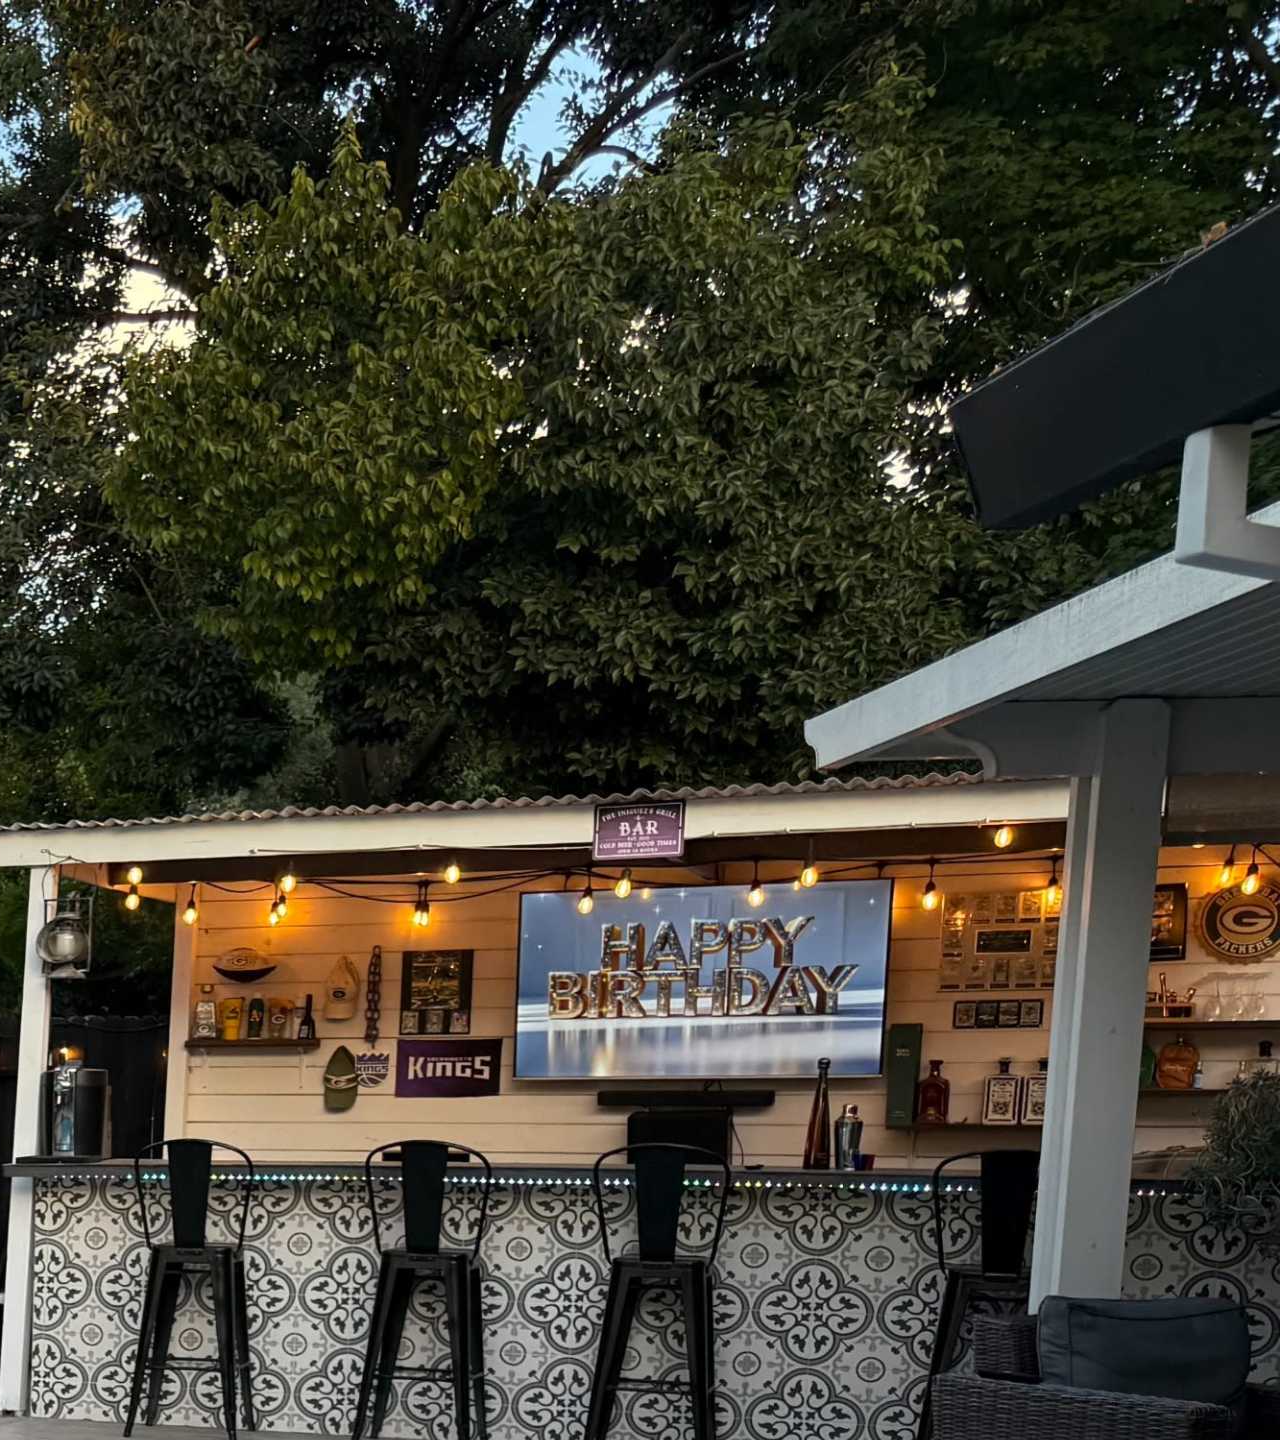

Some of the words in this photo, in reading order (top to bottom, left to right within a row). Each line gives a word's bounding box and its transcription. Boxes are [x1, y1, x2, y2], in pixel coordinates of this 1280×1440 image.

[619, 820, 659, 836] BAR
[601, 915, 816, 971] HAPPY
[1214, 936, 1273, 954] PACKERS
[548, 963, 860, 1020] BIRTHDAY
